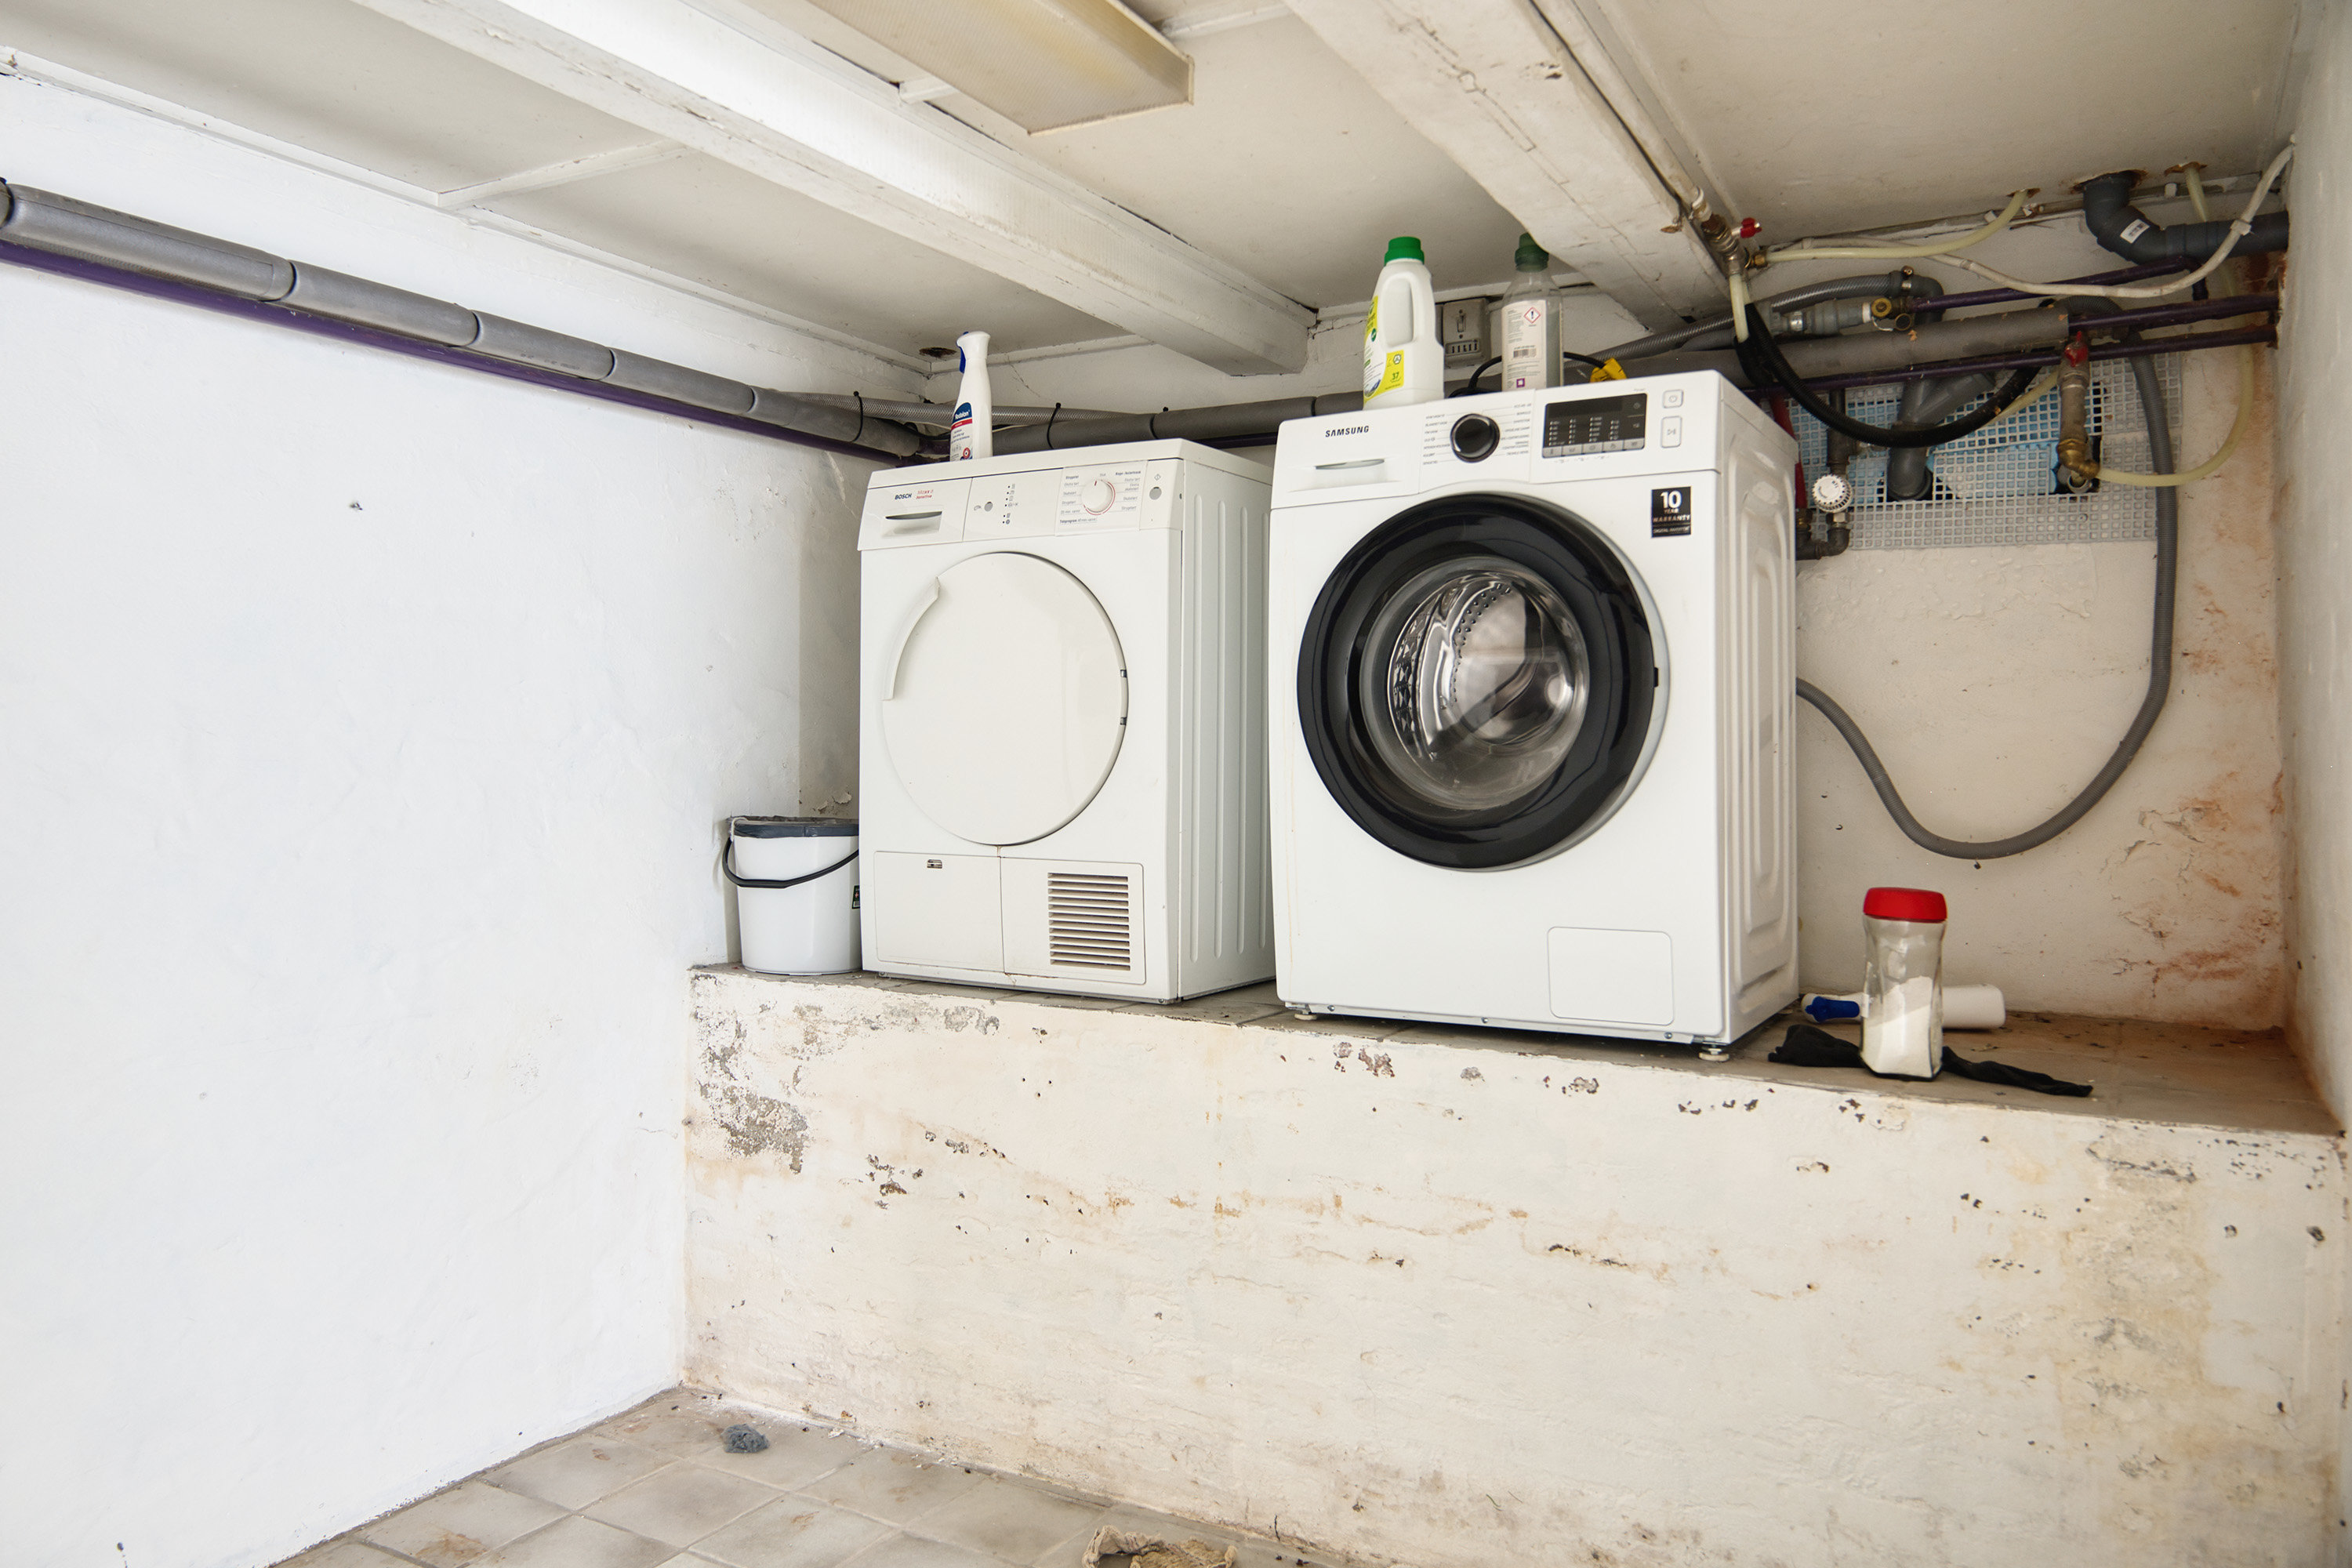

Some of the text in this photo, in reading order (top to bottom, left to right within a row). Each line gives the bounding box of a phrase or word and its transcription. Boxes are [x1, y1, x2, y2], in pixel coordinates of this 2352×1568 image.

[1392, 372, 1399, 380] 37
[954, 411, 969, 420] Rodalon
[1325, 425, 1370, 437] SAMSUNG
[1661, 491, 1682, 509] 10
[1653, 514, 1690, 523] WARRANTY
